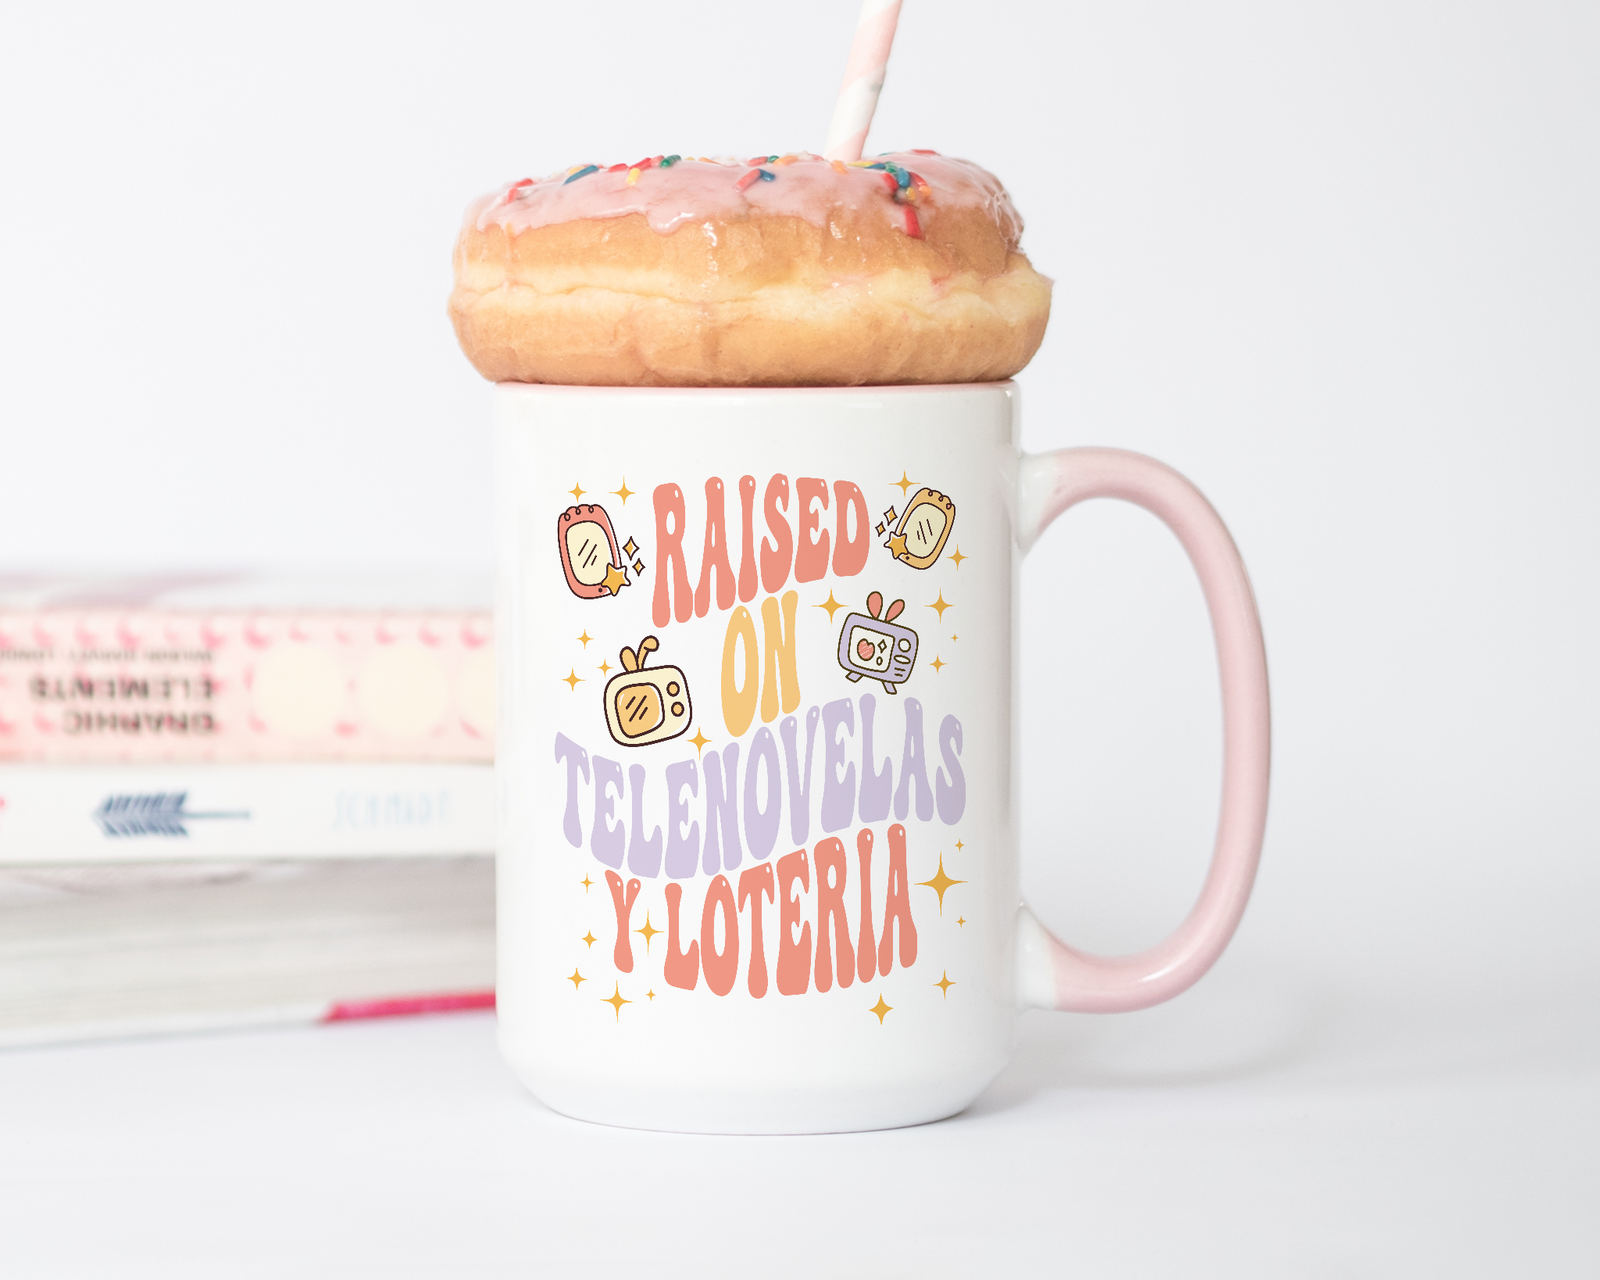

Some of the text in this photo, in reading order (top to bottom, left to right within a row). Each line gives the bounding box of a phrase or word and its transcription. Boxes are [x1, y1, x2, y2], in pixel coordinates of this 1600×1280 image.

[651, 473, 870, 628] RAISED
[721, 590, 801, 737] ON
[555, 693, 966, 880] TELENOVELAS
[604, 824, 918, 999] Y LOTERIA
